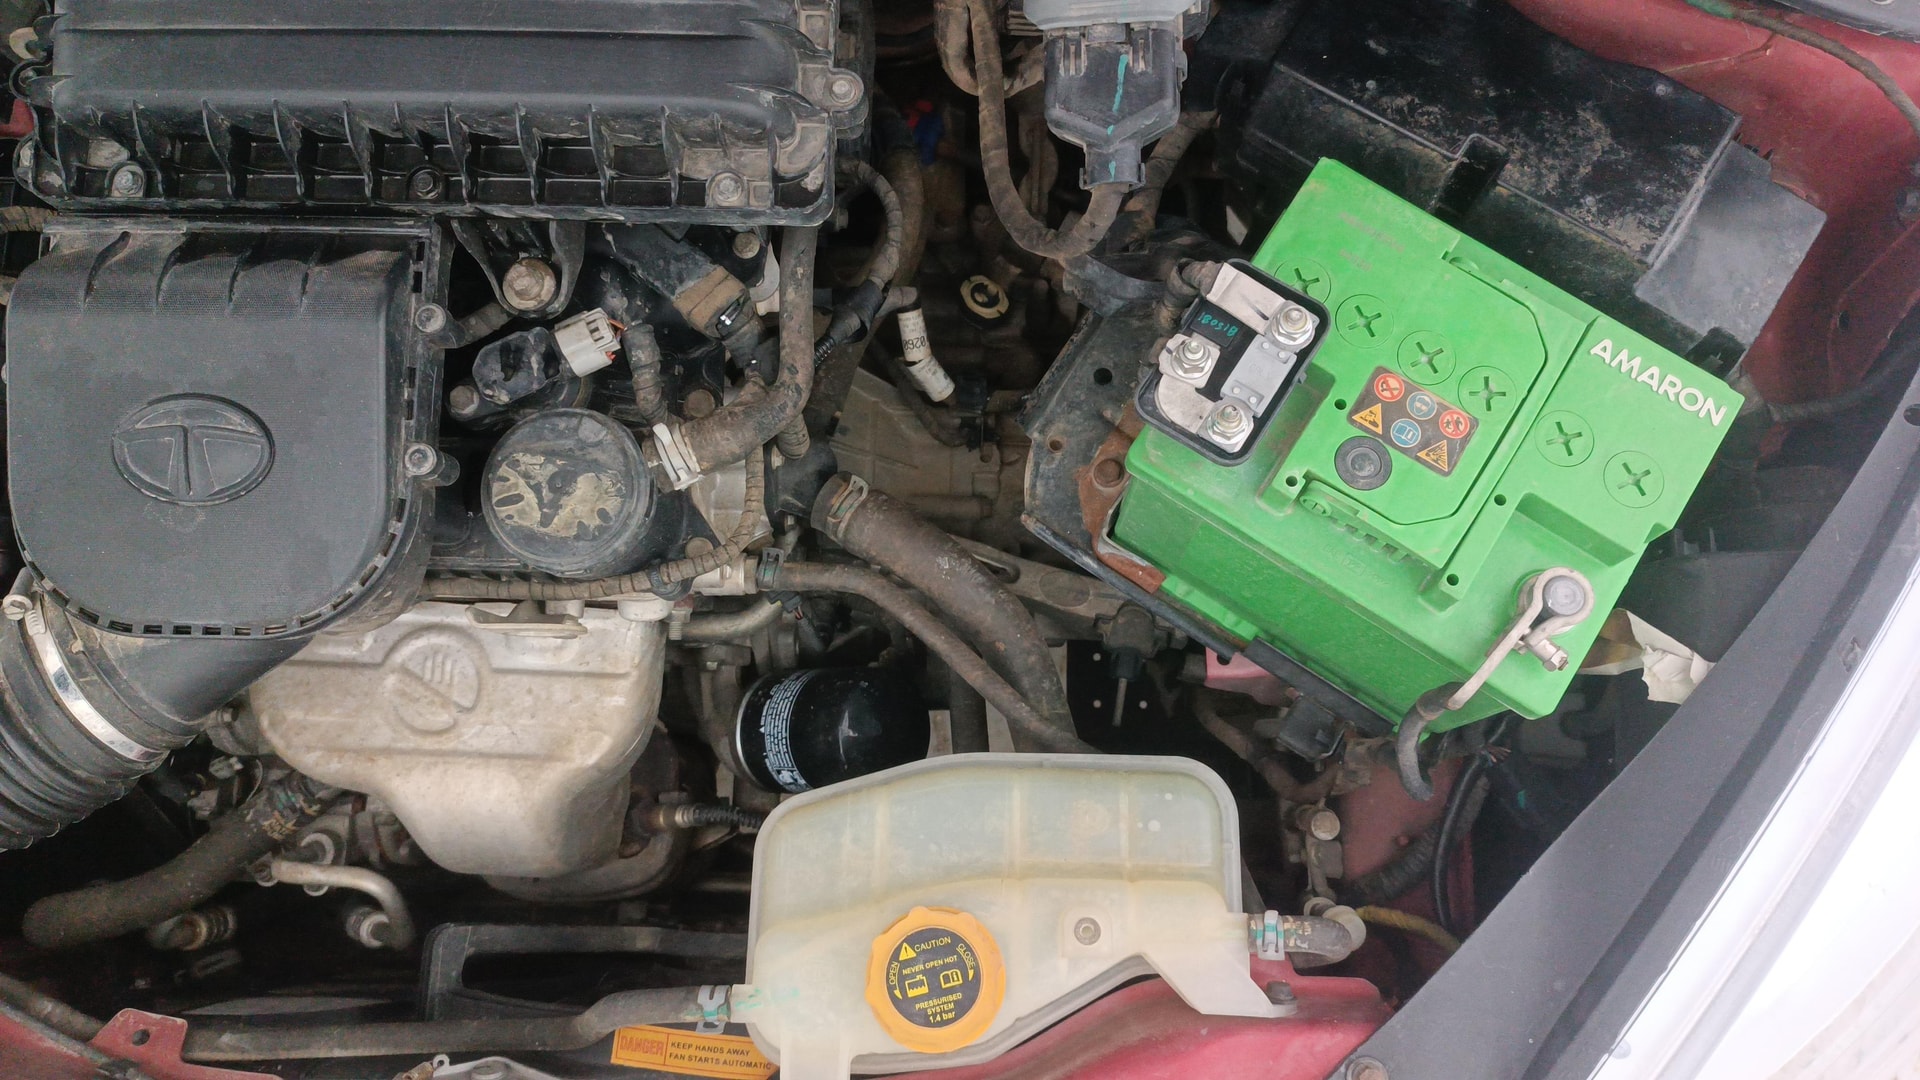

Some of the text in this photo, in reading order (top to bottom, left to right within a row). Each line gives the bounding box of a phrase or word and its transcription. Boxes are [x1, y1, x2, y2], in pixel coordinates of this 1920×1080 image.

[1590, 338, 1727, 427] AMARON
[914, 936, 951, 952] CAUTION
[958, 943, 976, 969] CLOSE
[888, 961, 898, 985] OPEN
[902, 955, 958, 976] NEVER OPEN HOT
[915, 992, 962, 1010] PRESSURISED
[927, 1003, 955, 1015] SYSTEM
[929, 1011, 956, 1024] 1.4 bar
[620, 1035, 664, 1056] DANGER
[671, 1041, 750, 1057] KEEP HANDS AWAY
[669, 1053, 686, 1062] FAN
[722, 1060, 772, 1070] AUTOMATIC
